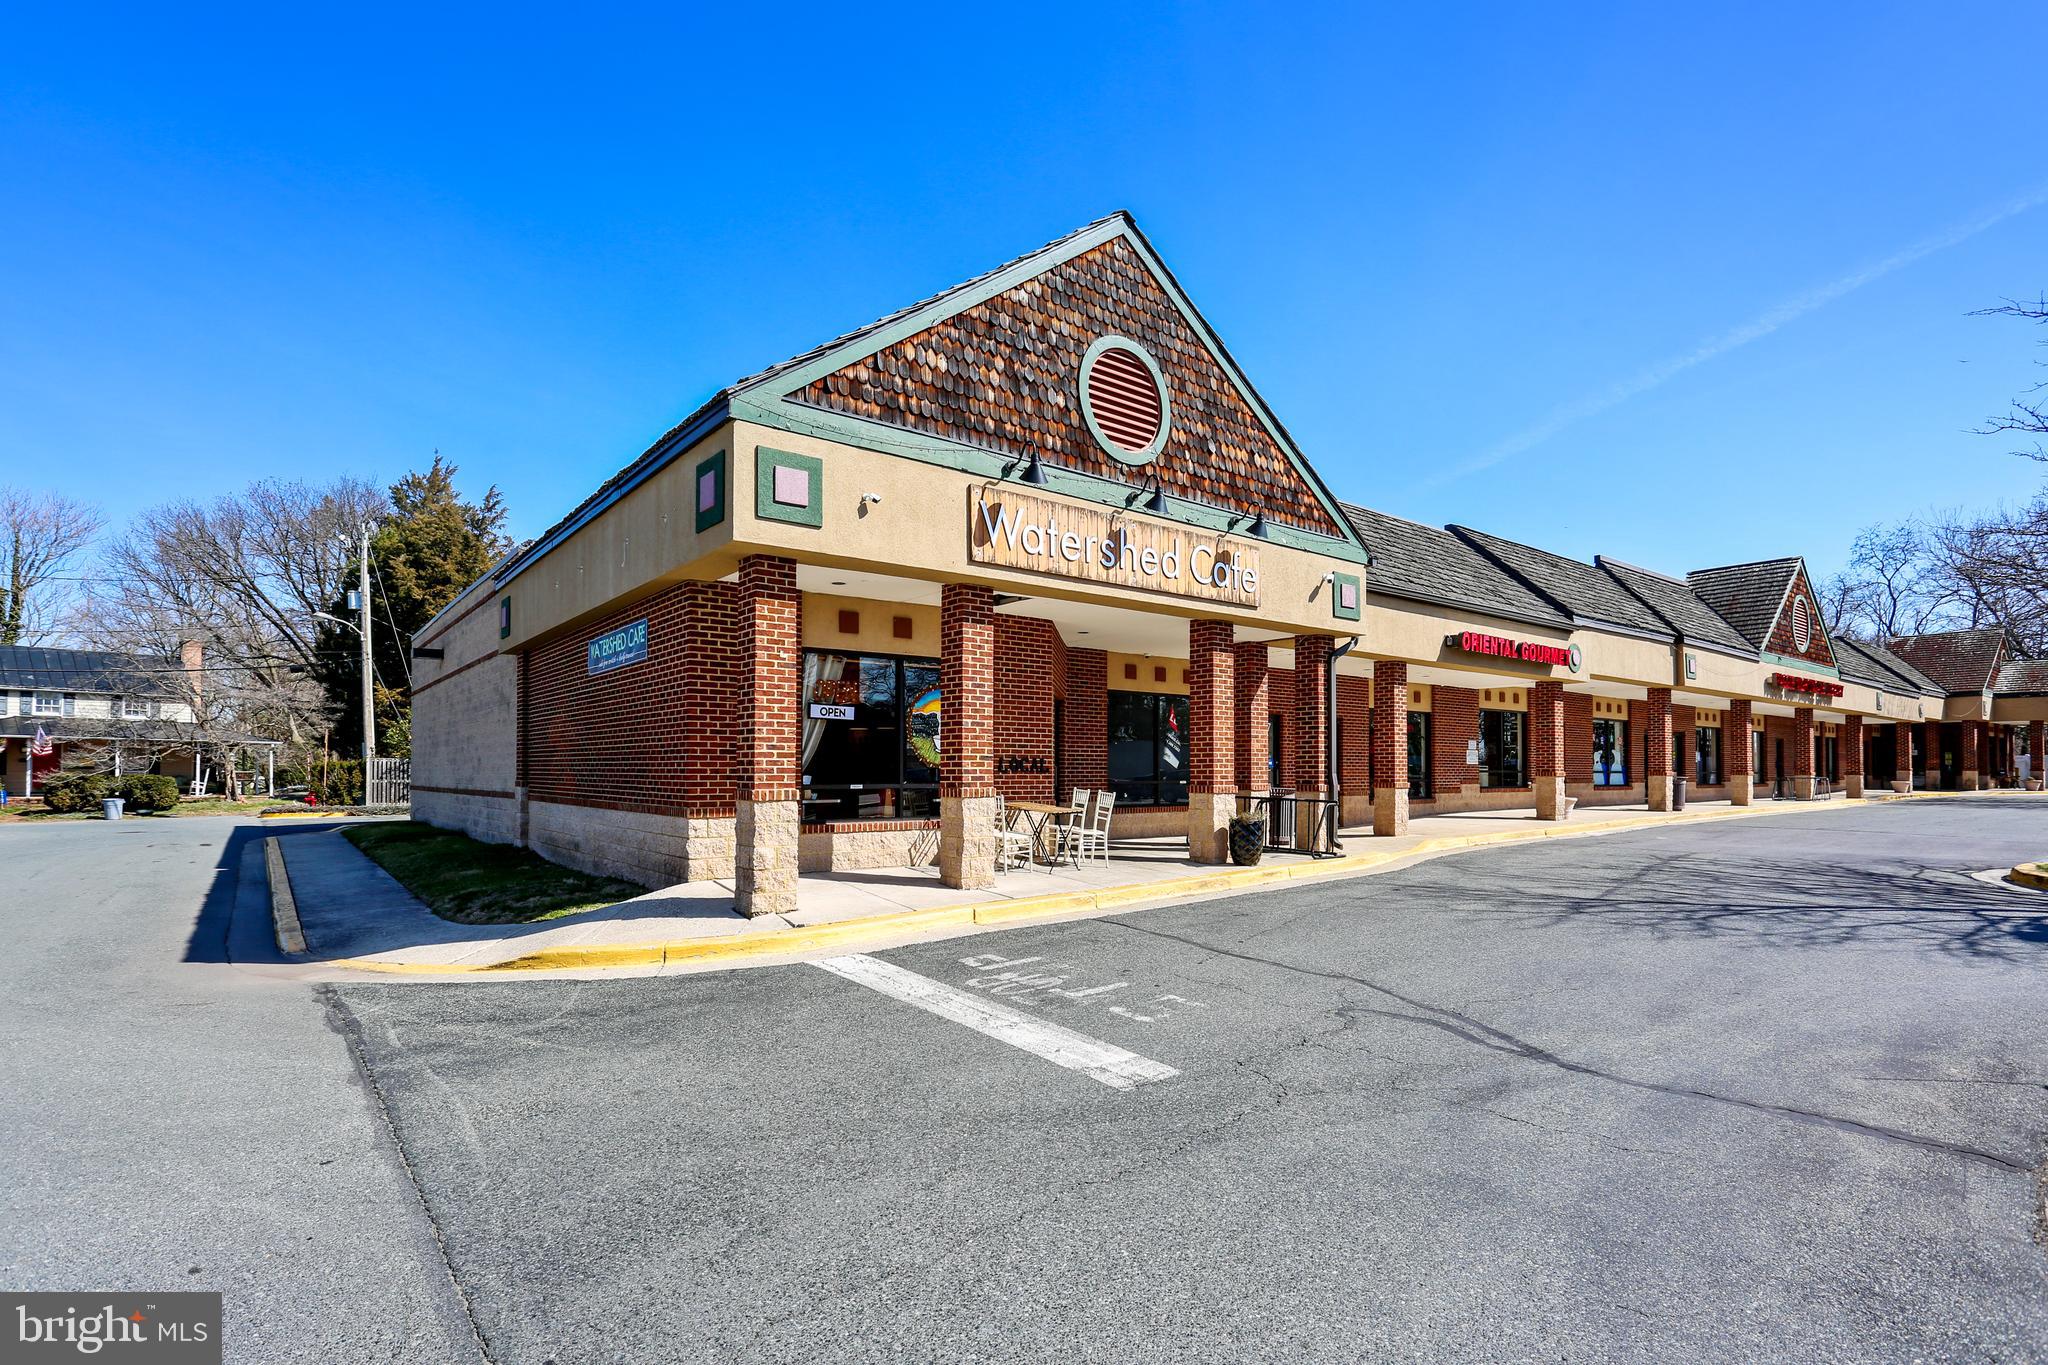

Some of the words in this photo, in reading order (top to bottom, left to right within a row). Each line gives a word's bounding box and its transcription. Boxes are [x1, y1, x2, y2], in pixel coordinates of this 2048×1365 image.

[979, 499, 1180, 580] Watershed
[1190, 545, 1258, 594] Cafe
[591, 633, 627, 658] WATERSHED
[628, 625, 646, 647] CAFE
[1461, 631, 1519, 659] ORIENTAL
[1520, 642, 1571, 667] GOURMET
[819, 707, 846, 718] OPEN
